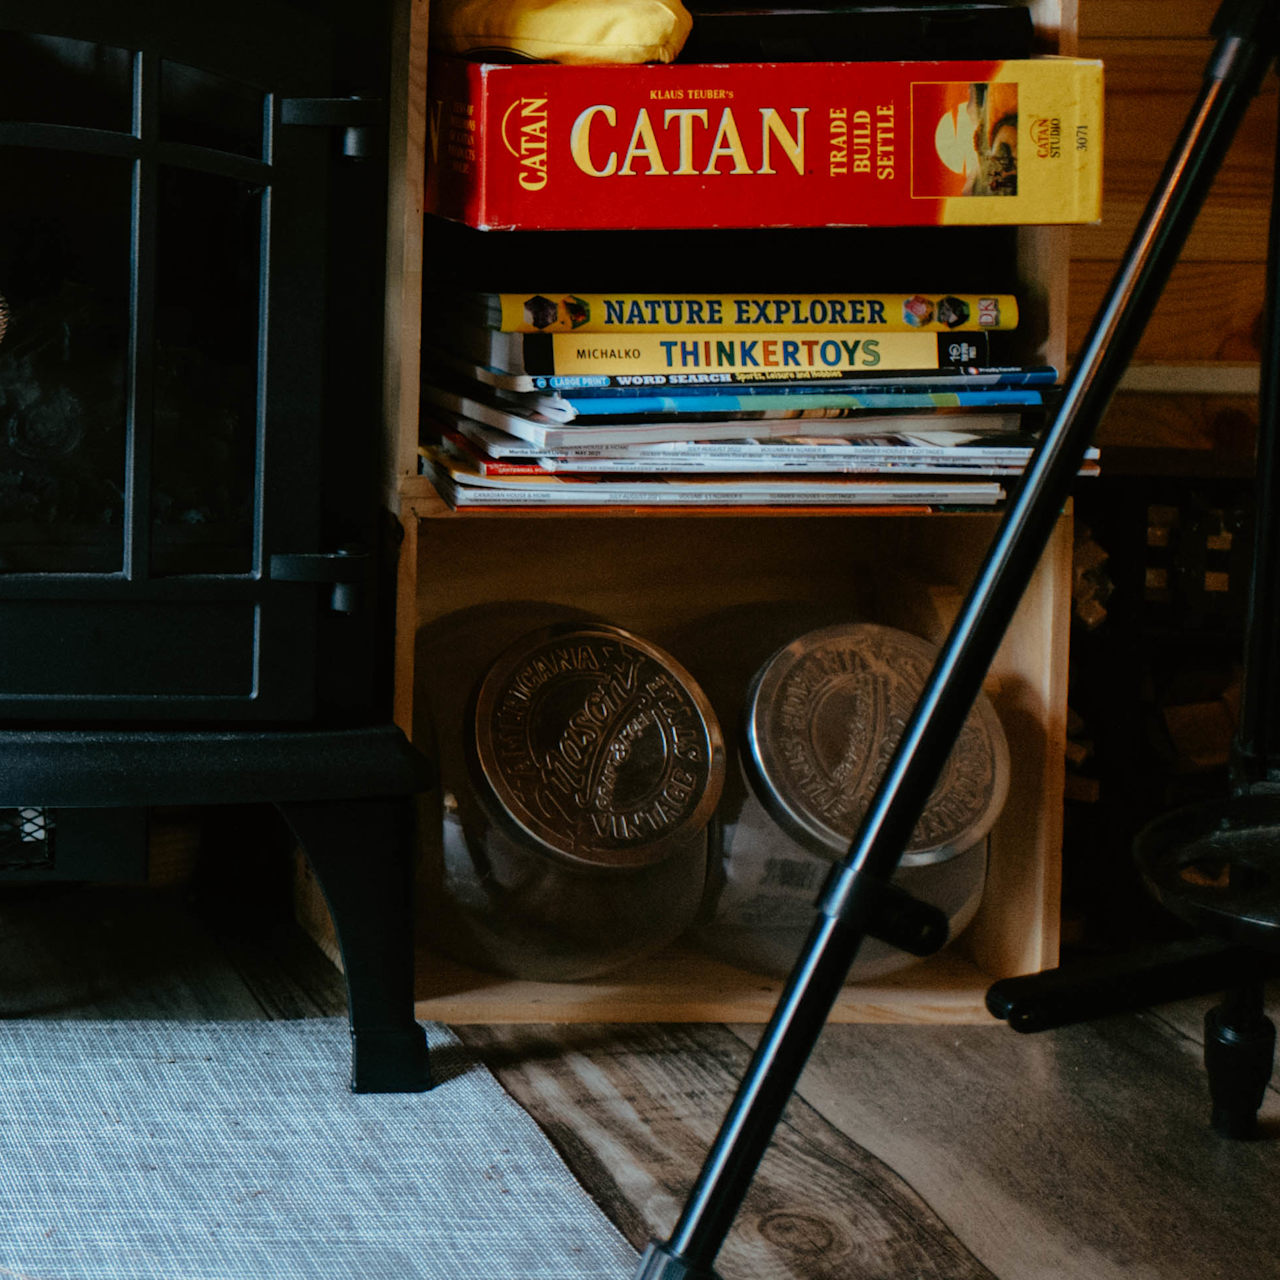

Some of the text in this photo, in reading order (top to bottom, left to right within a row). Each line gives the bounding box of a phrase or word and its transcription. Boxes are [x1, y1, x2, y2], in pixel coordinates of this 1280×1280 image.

[650, 89, 684, 100] KLAUS
[518, 96, 548, 191] CATAN
[570, 104, 810, 178] CATAN
[830, 108, 847, 177] TRADE
[853, 110, 871, 173] BUILD
[877, 104, 895, 180] SETTLE
[1037, 118, 1049, 158] CATAN
[1050, 118, 1062, 158] STUDIO
[1076, 124, 1088, 151] 3071
[604, 300, 887, 325] NATURE EXPLORER
[979, 299, 995, 326] DK
[577, 340, 881, 367] MICHALKO THINKERTOYS
[554, 377, 580, 388] LARGE
[581, 376, 608, 387] PRINT
[616, 375, 666, 387] WORD
[669, 373, 733, 385] SEARCH
[735, 372, 765, 383] Sports,
[766, 371, 795, 381] Leisure
[796, 371, 811, 379] and
